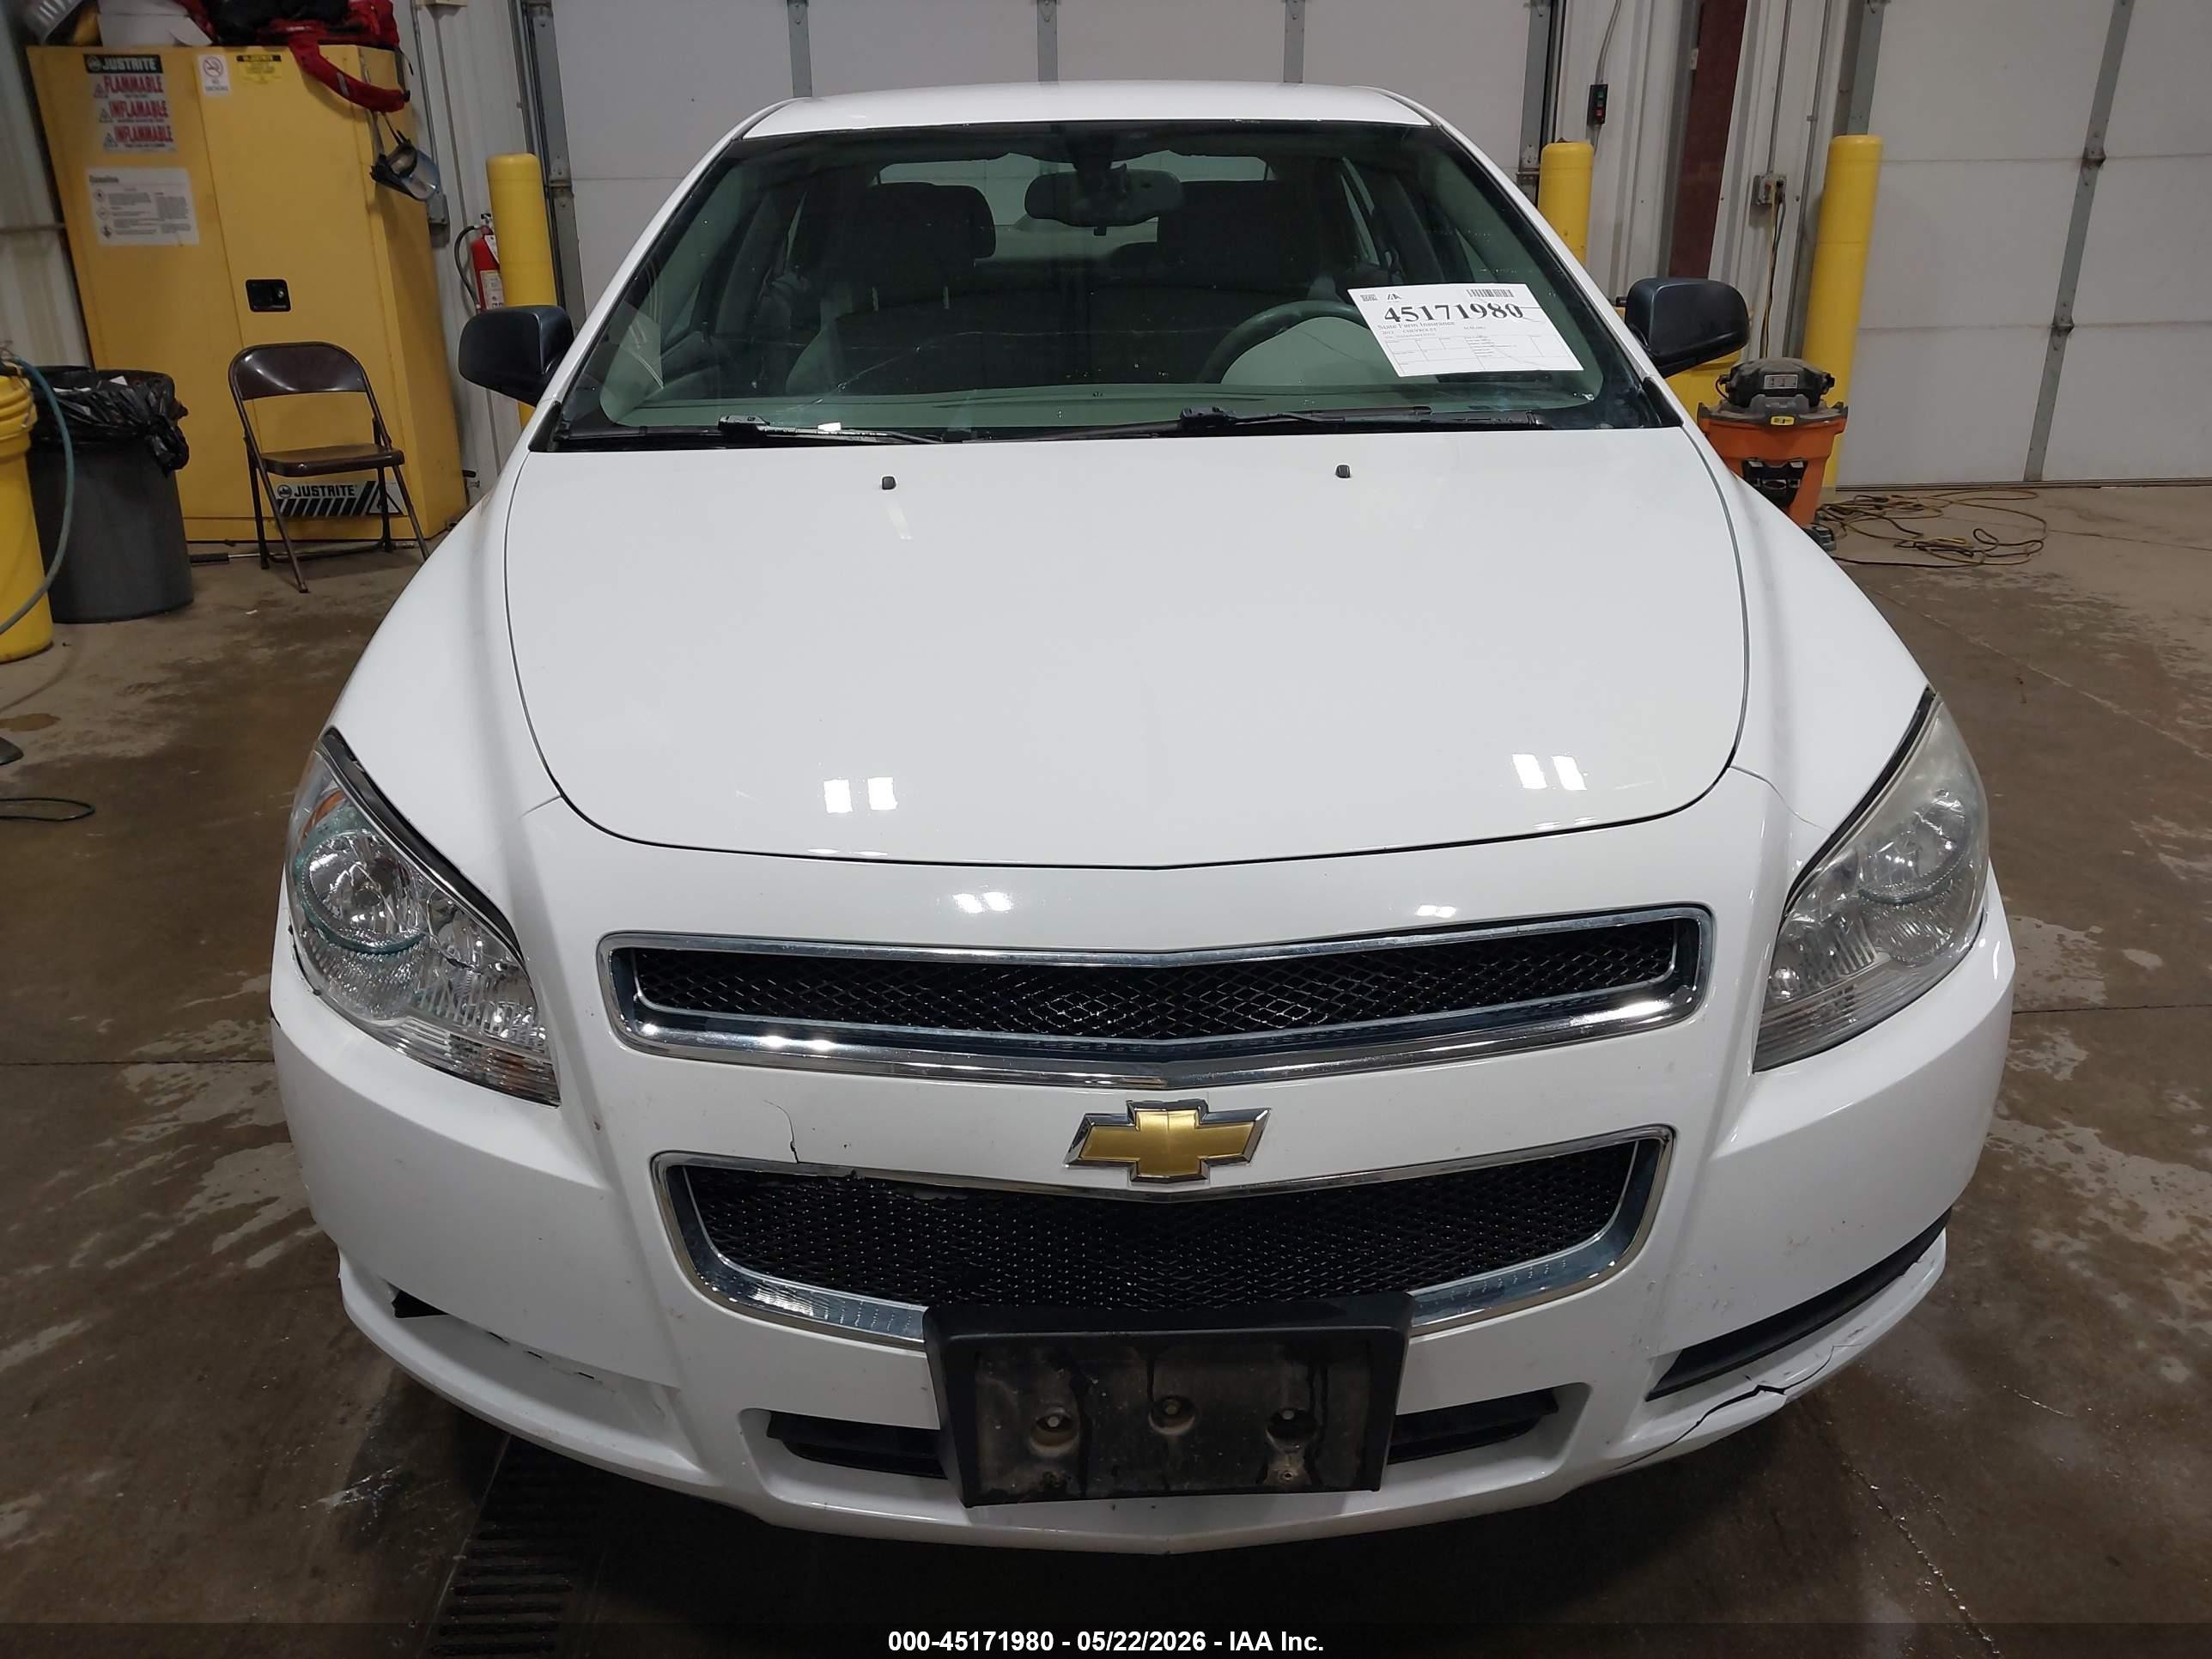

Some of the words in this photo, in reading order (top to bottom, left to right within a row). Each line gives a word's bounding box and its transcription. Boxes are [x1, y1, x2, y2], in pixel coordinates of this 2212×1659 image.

[102, 58, 157, 70] JUSTRITE
[103, 75, 163, 94] FLAMMABLE
[109, 100, 169, 118] INFLAMABLE
[1383, 302, 1524, 323] 45171980
[294, 484, 356, 497] JUSTRITE
